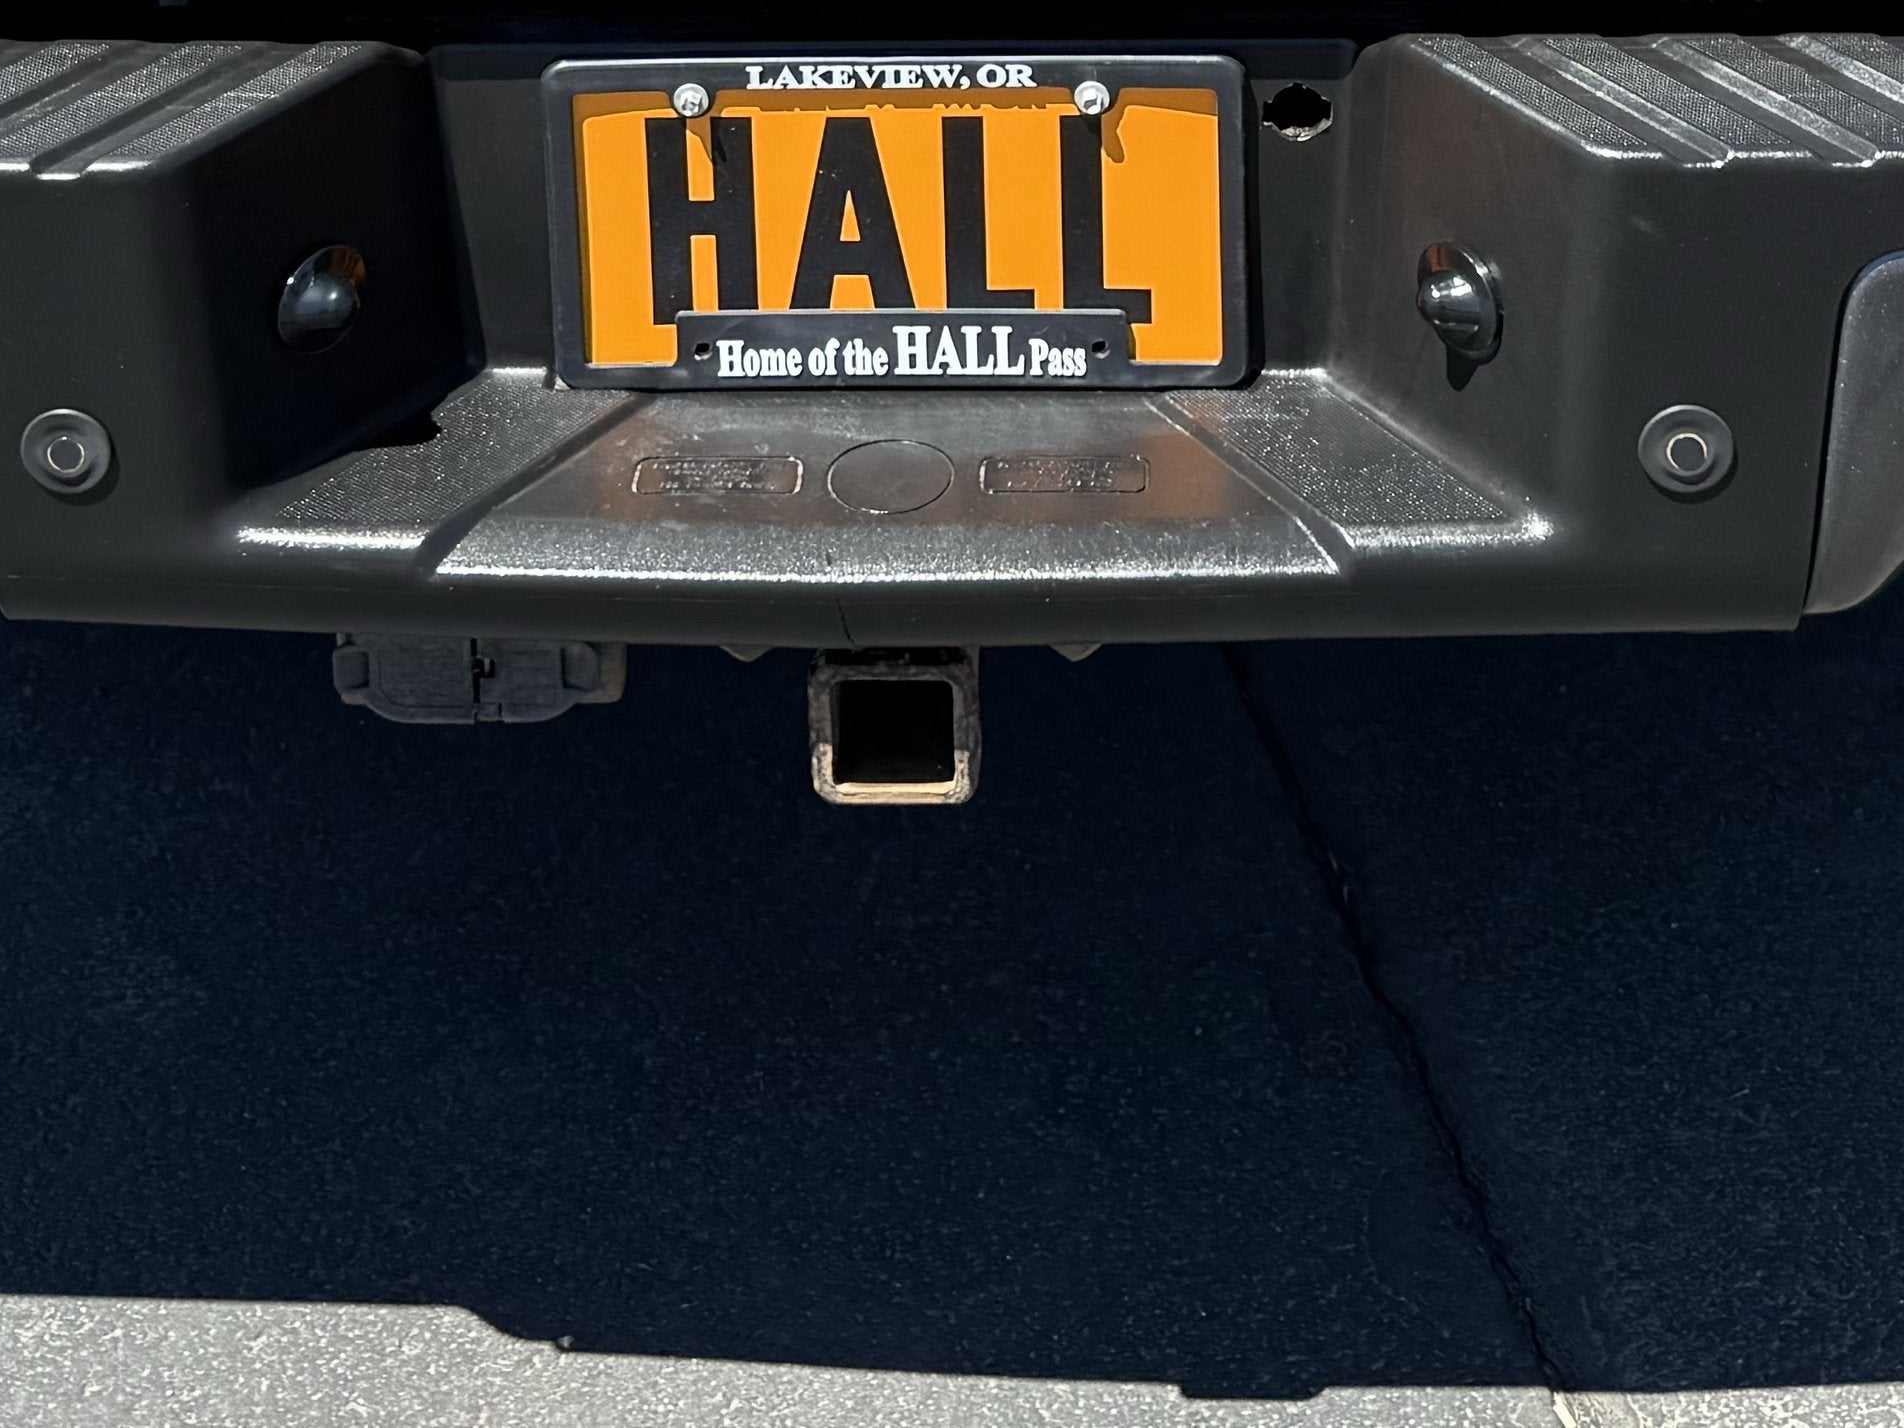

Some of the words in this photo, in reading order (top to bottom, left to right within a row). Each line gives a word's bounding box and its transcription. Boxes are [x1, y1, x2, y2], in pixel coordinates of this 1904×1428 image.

[745, 64, 971, 90] LAKEVIEW,
[976, 63, 1038, 88] OR
[644, 114, 1153, 325] HALL
[716, 339, 803, 377] Home
[807, 337, 841, 376] of
[842, 337, 889, 376] the
[892, 325, 1025, 376] HALL
[1028, 337, 1088, 377] Pass
